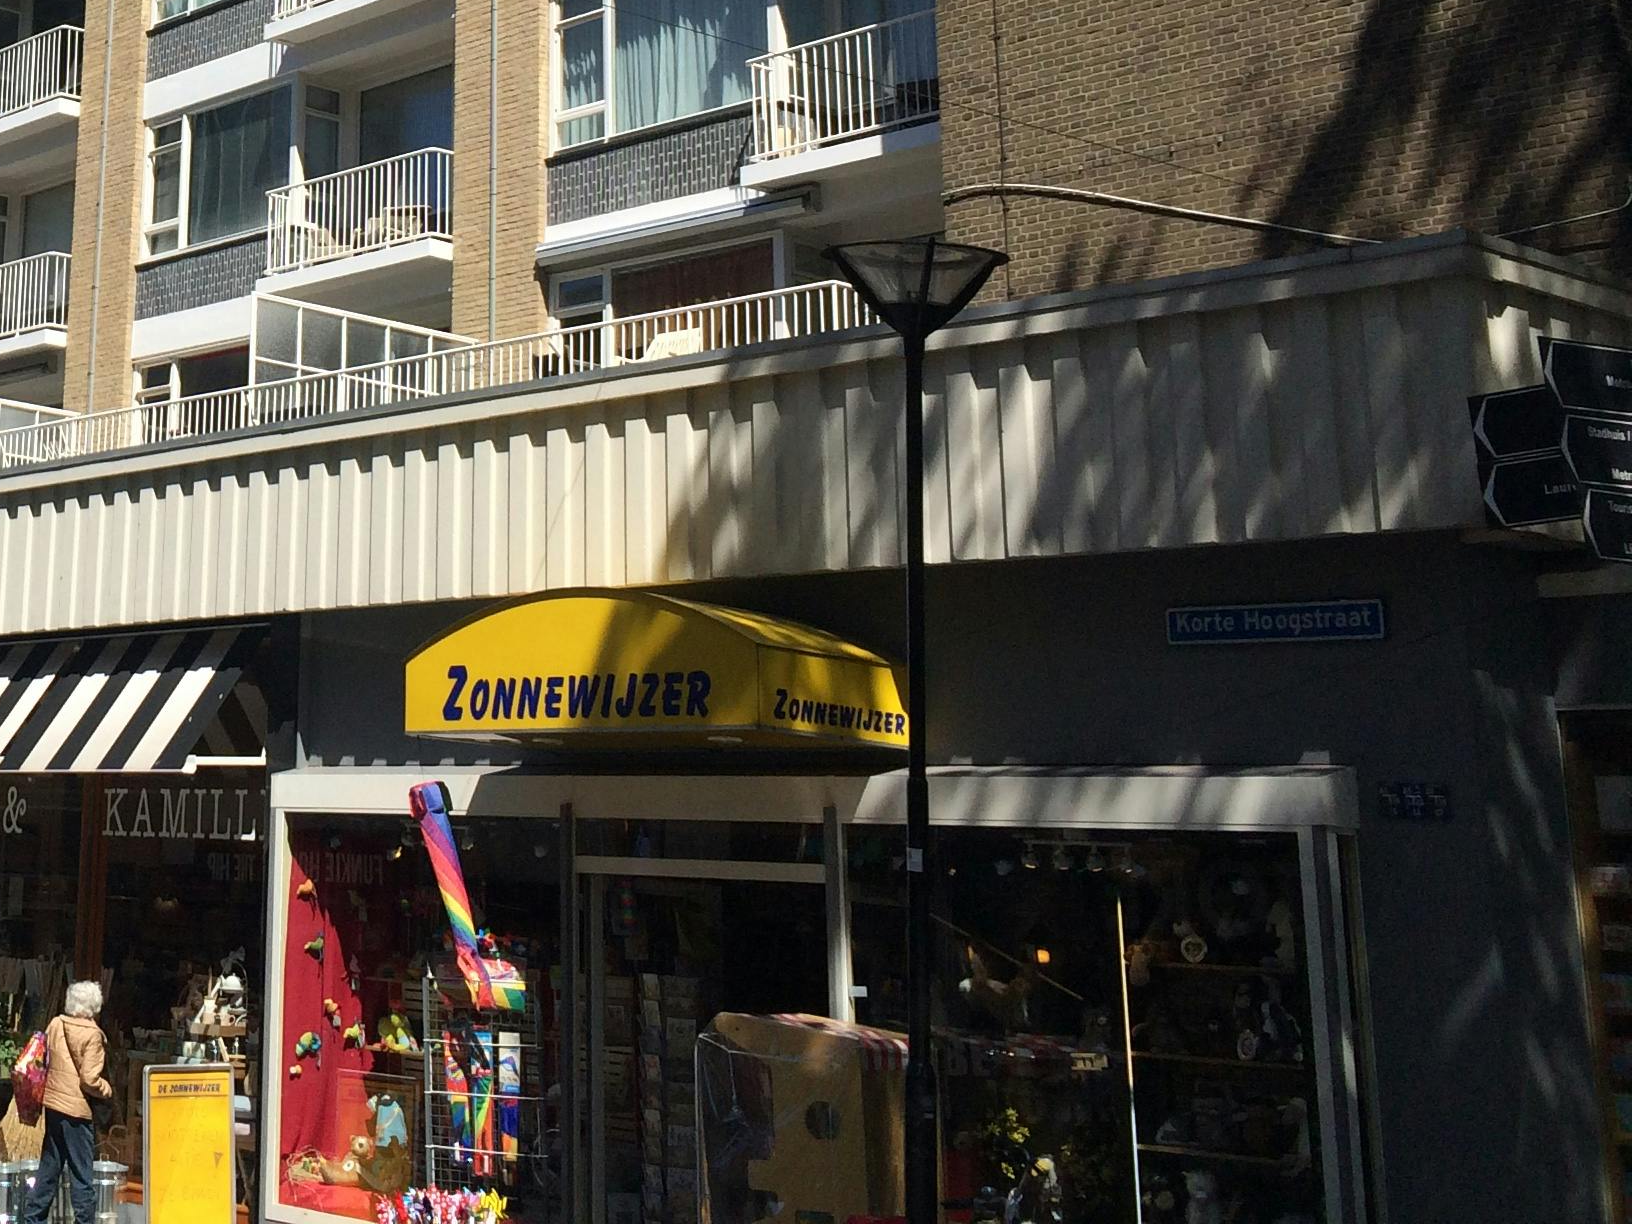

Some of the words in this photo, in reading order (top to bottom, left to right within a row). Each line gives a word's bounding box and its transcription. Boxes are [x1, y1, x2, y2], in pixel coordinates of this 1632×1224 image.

[1176, 612, 1235, 633] Korte
[1244, 607, 1372, 635] Hoogstraat
[442, 664, 711, 721] ZONNEWIJZER
[774, 688, 906, 736] ZONNEWIJZER
[2, 785, 28, 835] &
[102, 787, 266, 841] KAMILL
